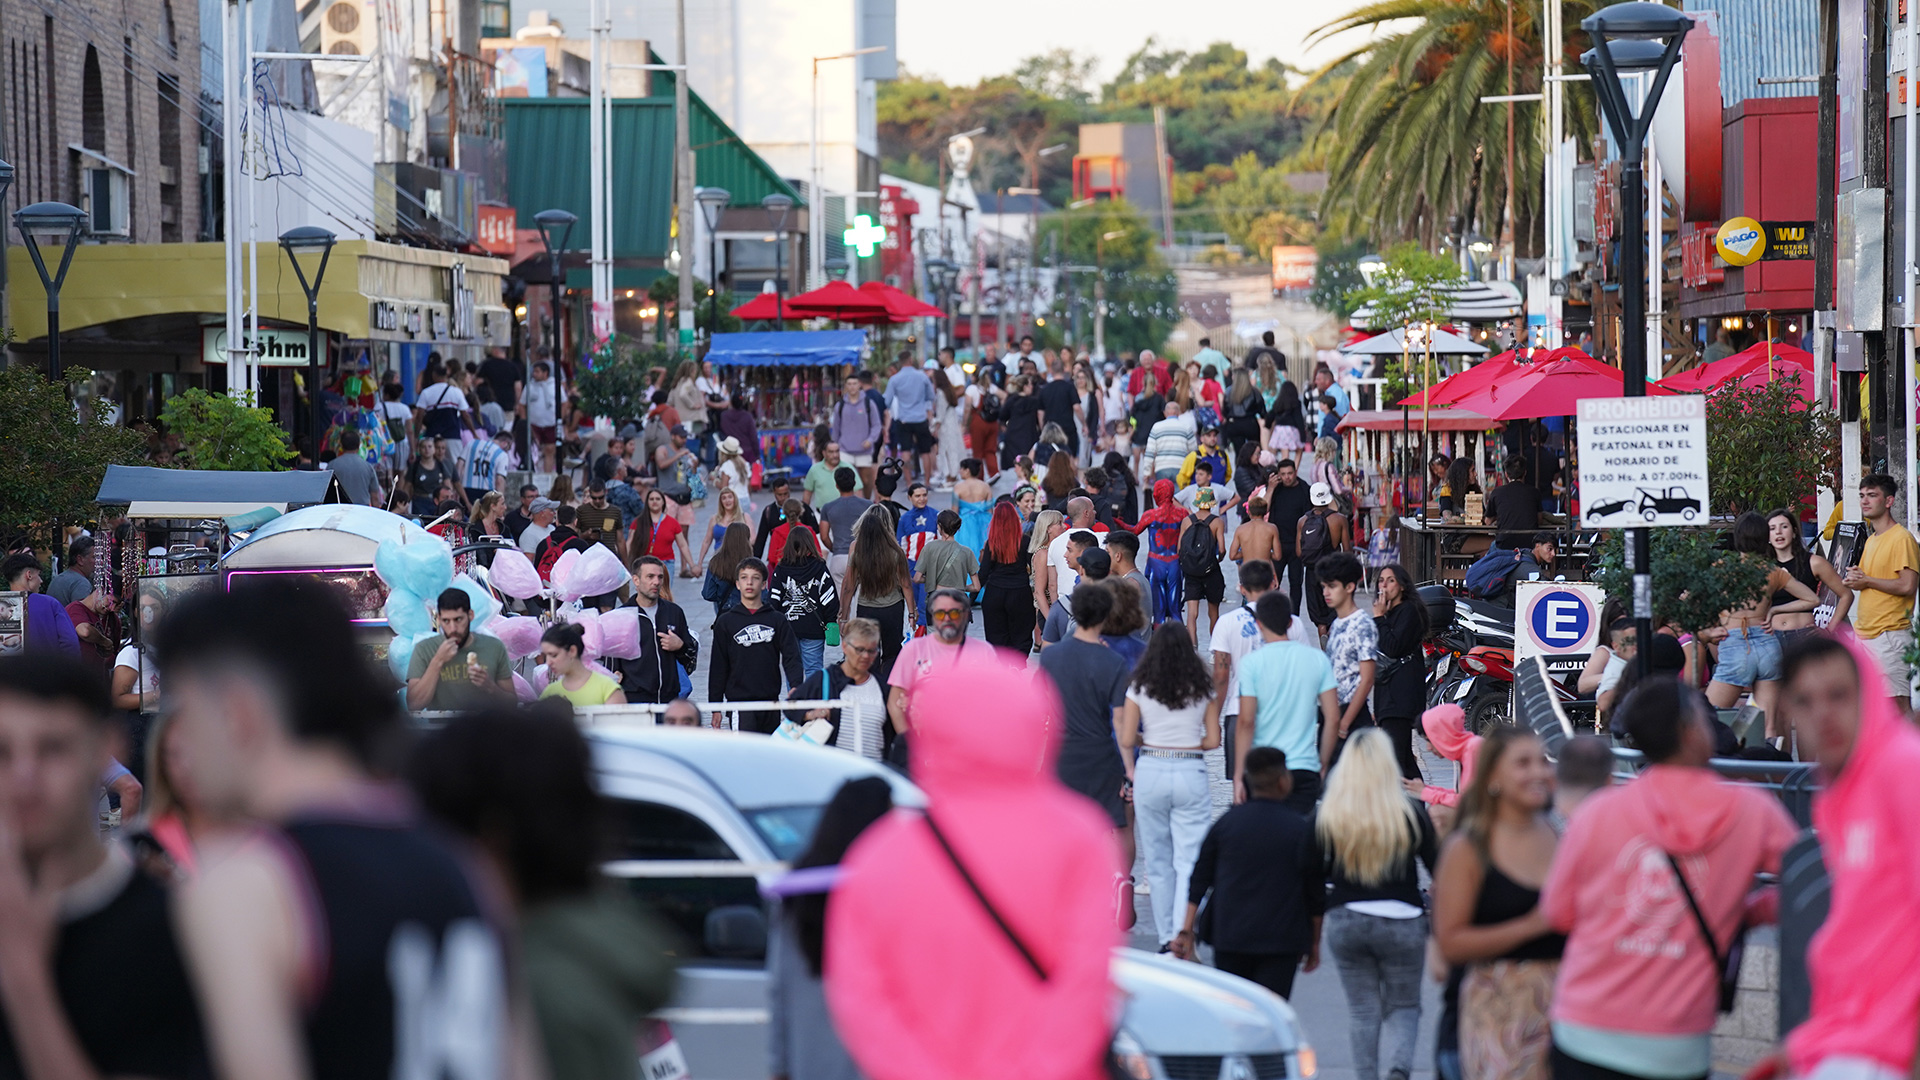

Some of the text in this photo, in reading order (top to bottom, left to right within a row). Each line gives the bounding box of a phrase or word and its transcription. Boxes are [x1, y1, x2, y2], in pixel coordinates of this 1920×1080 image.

[1723, 230, 1759, 246] PAGO
[1584, 399, 1697, 420] PROHIBIDO
[1593, 424, 1689, 435] ESTACIONAR EN
[1591, 439, 1692, 451] PEATONAL EN EL
[473, 458, 490, 478] 10
[1604, 456, 1679, 466] HORARIO DE
[1583, 473, 1614, 482] 19.00
[1640, 473, 1648, 481] A
[1546, 600, 1579, 639] E
